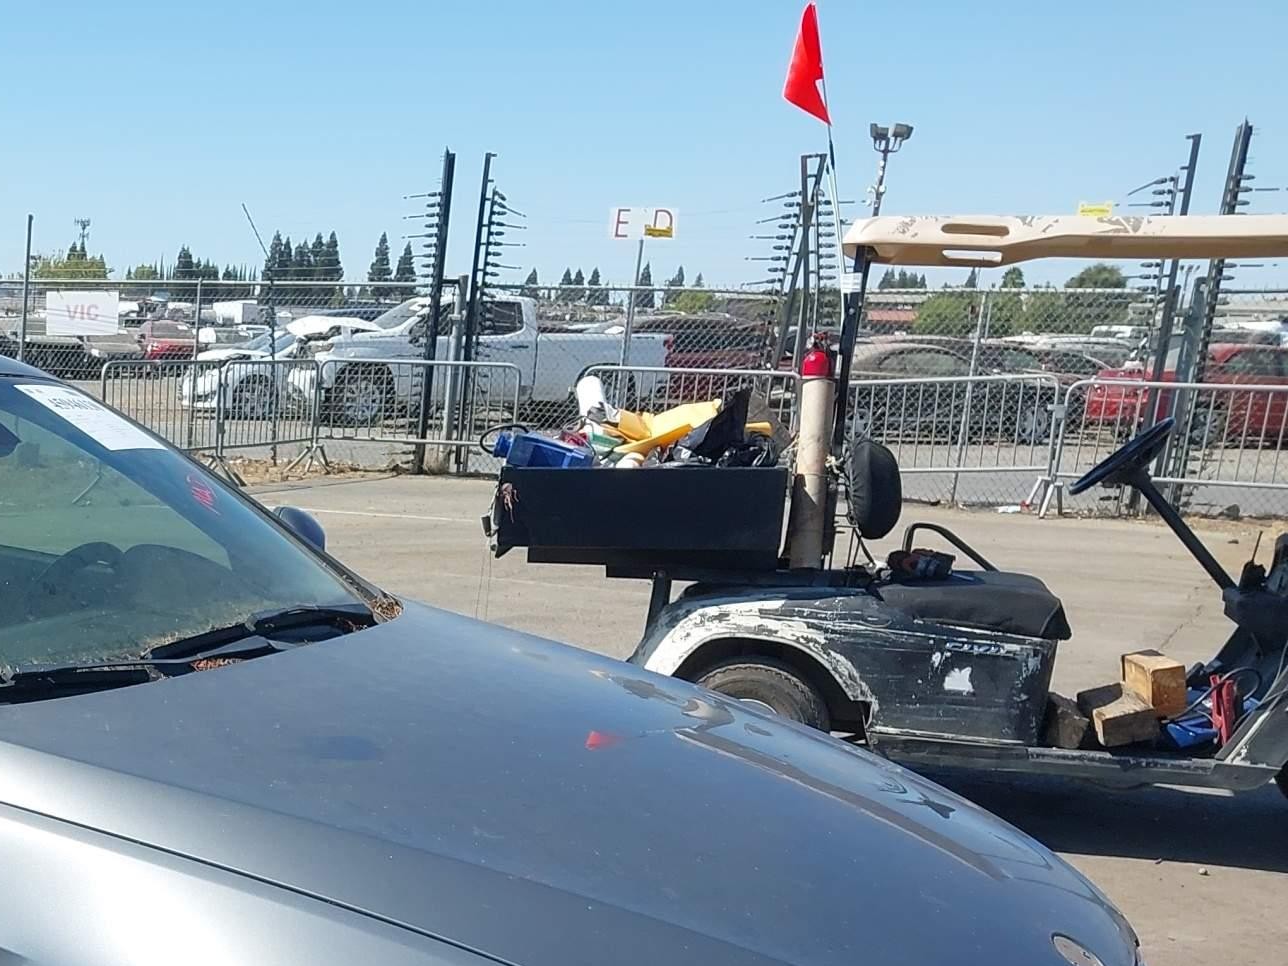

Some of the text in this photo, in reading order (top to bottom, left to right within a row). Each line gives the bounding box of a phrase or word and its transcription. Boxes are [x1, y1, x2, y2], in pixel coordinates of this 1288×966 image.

[614, 208, 674, 238] E D
[66, 303, 99, 321] VIC
